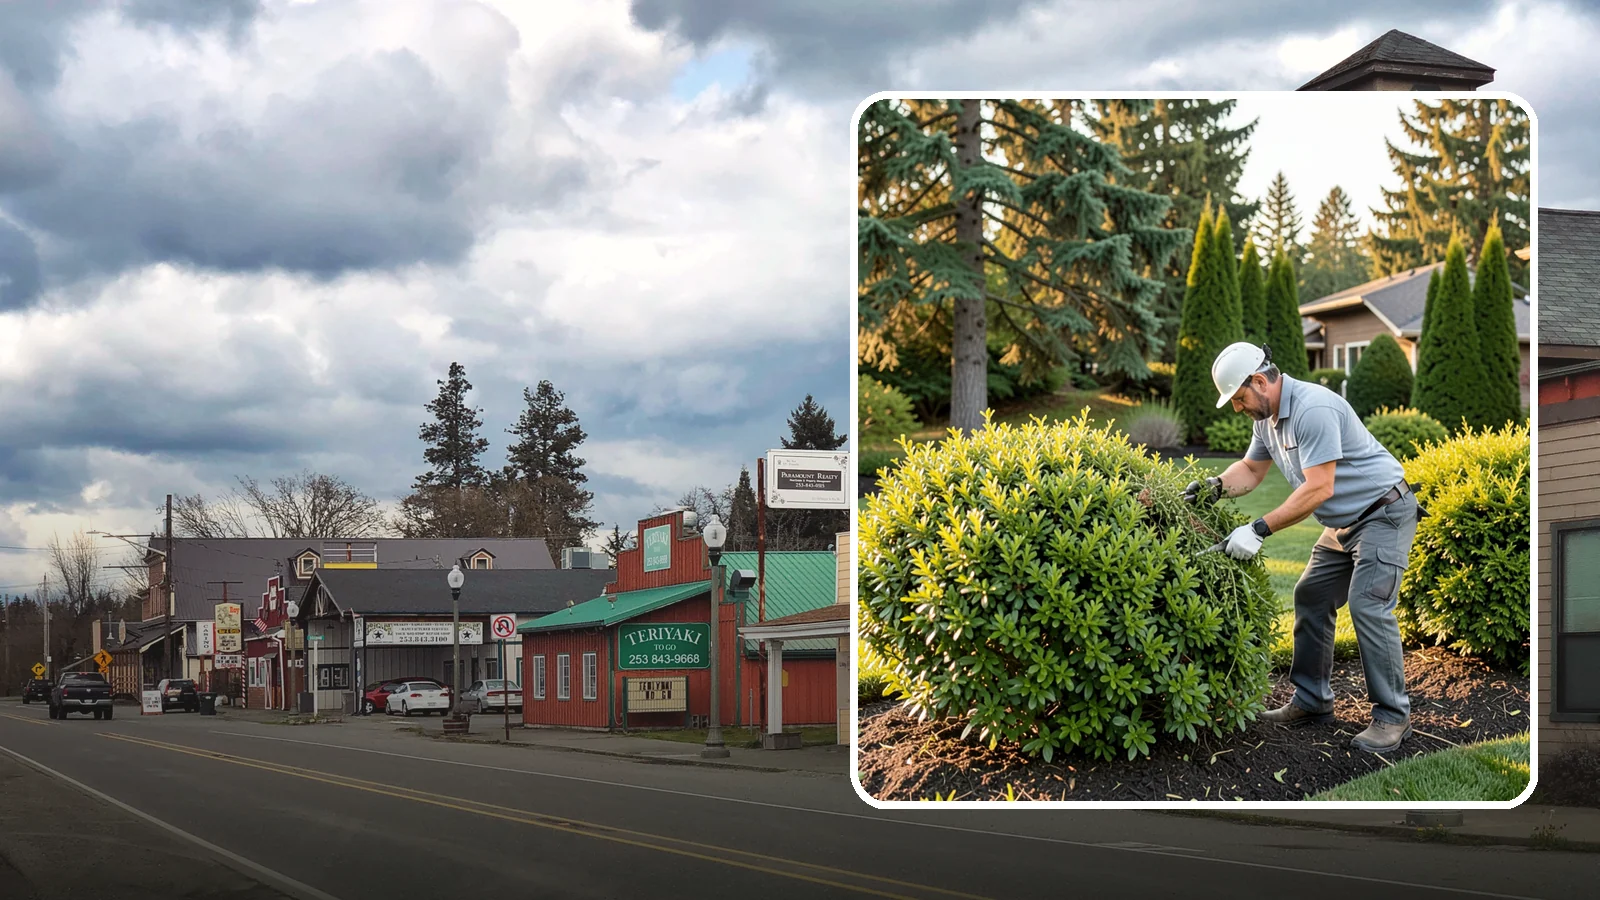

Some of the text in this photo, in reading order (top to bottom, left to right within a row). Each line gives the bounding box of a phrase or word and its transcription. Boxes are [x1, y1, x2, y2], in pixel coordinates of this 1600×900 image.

[624, 627, 702, 646] TERIYAKI
[628, 654, 700, 664] 253 843-9668
